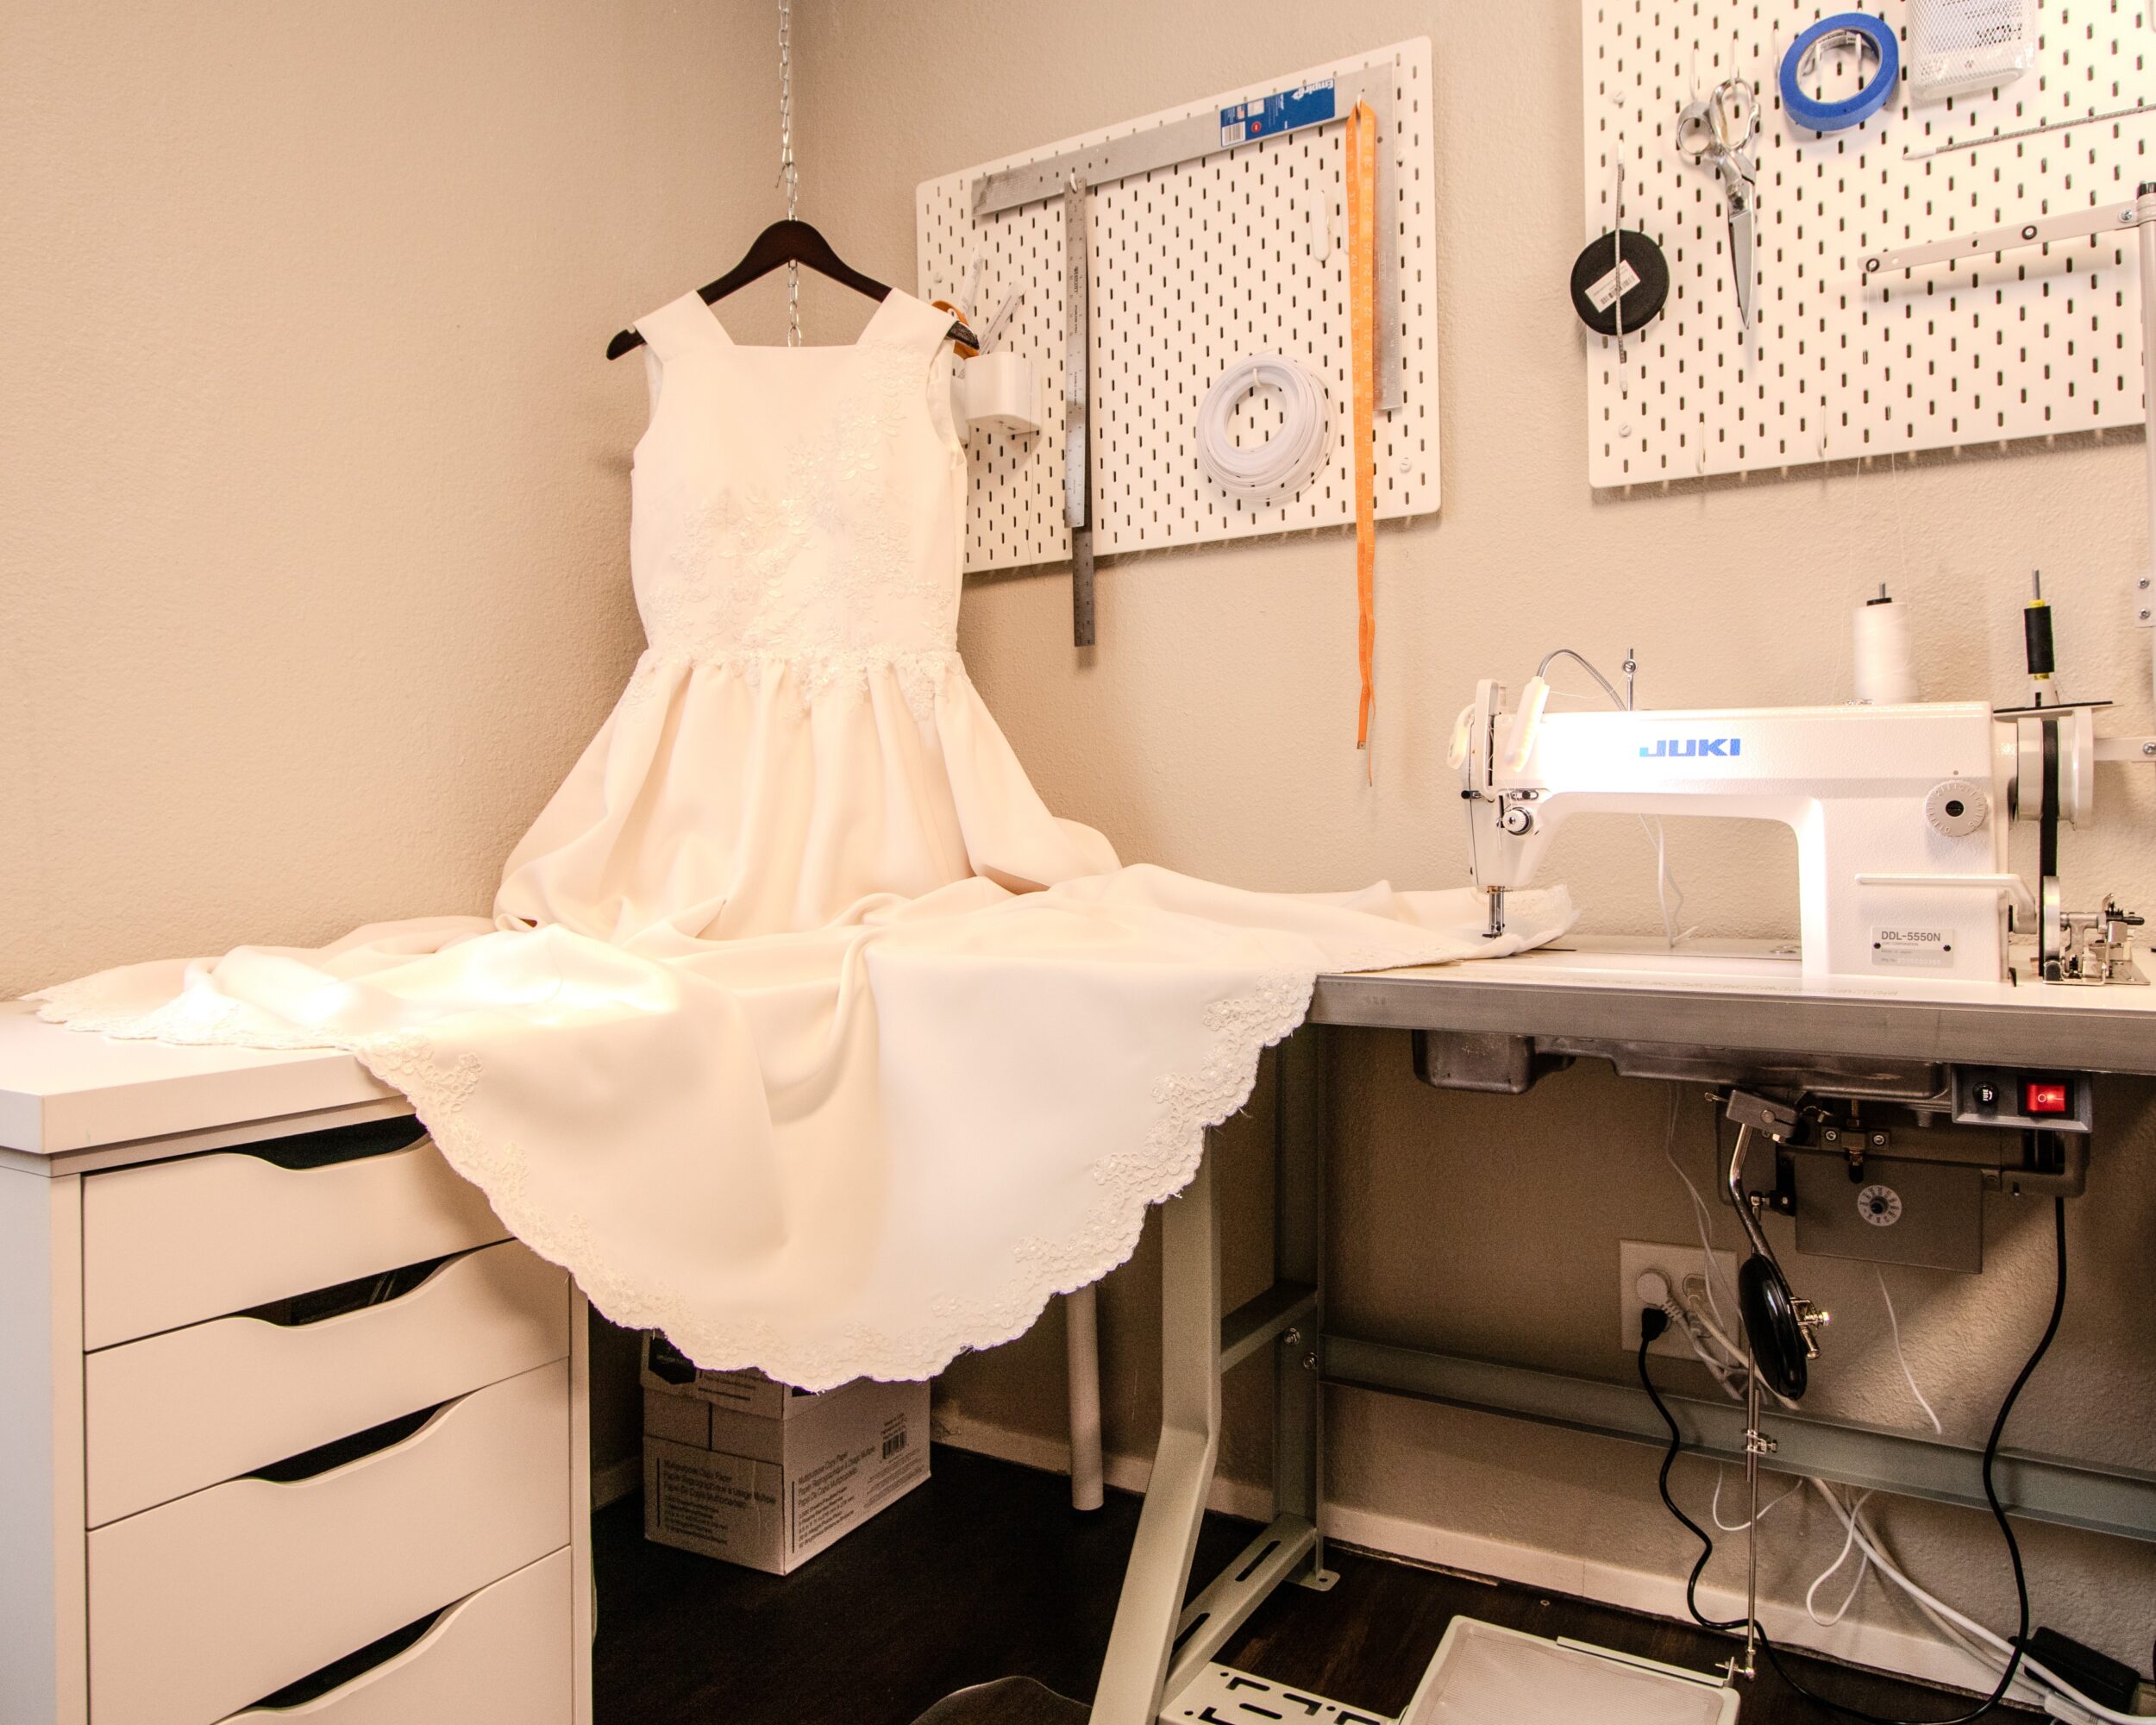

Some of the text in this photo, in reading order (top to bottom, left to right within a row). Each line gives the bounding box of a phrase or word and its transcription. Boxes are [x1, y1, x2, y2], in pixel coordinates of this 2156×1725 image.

[1349, 191, 1356, 202] 37
[1363, 242, 1372, 254] 25
[1351, 254, 1358, 267] 40
[1363, 263, 1371, 276] 24
[1363, 285, 1371, 297] 23
[1363, 306, 1372, 317] 22
[1363, 329, 1372, 340] 21
[1364, 349, 1371, 361] 20
[1365, 392, 1372, 403] 18
[1364, 414, 1372, 424] 17
[1365, 436, 1372, 446] 16
[1366, 456, 1373, 467] 15
[1366, 479, 1373, 489] 14
[1366, 500, 1373, 511] 13
[1367, 522, 1373, 531] 12
[1639, 738, 1740, 757] JUKI
[1881, 931, 1940, 942] DDL-5550N
